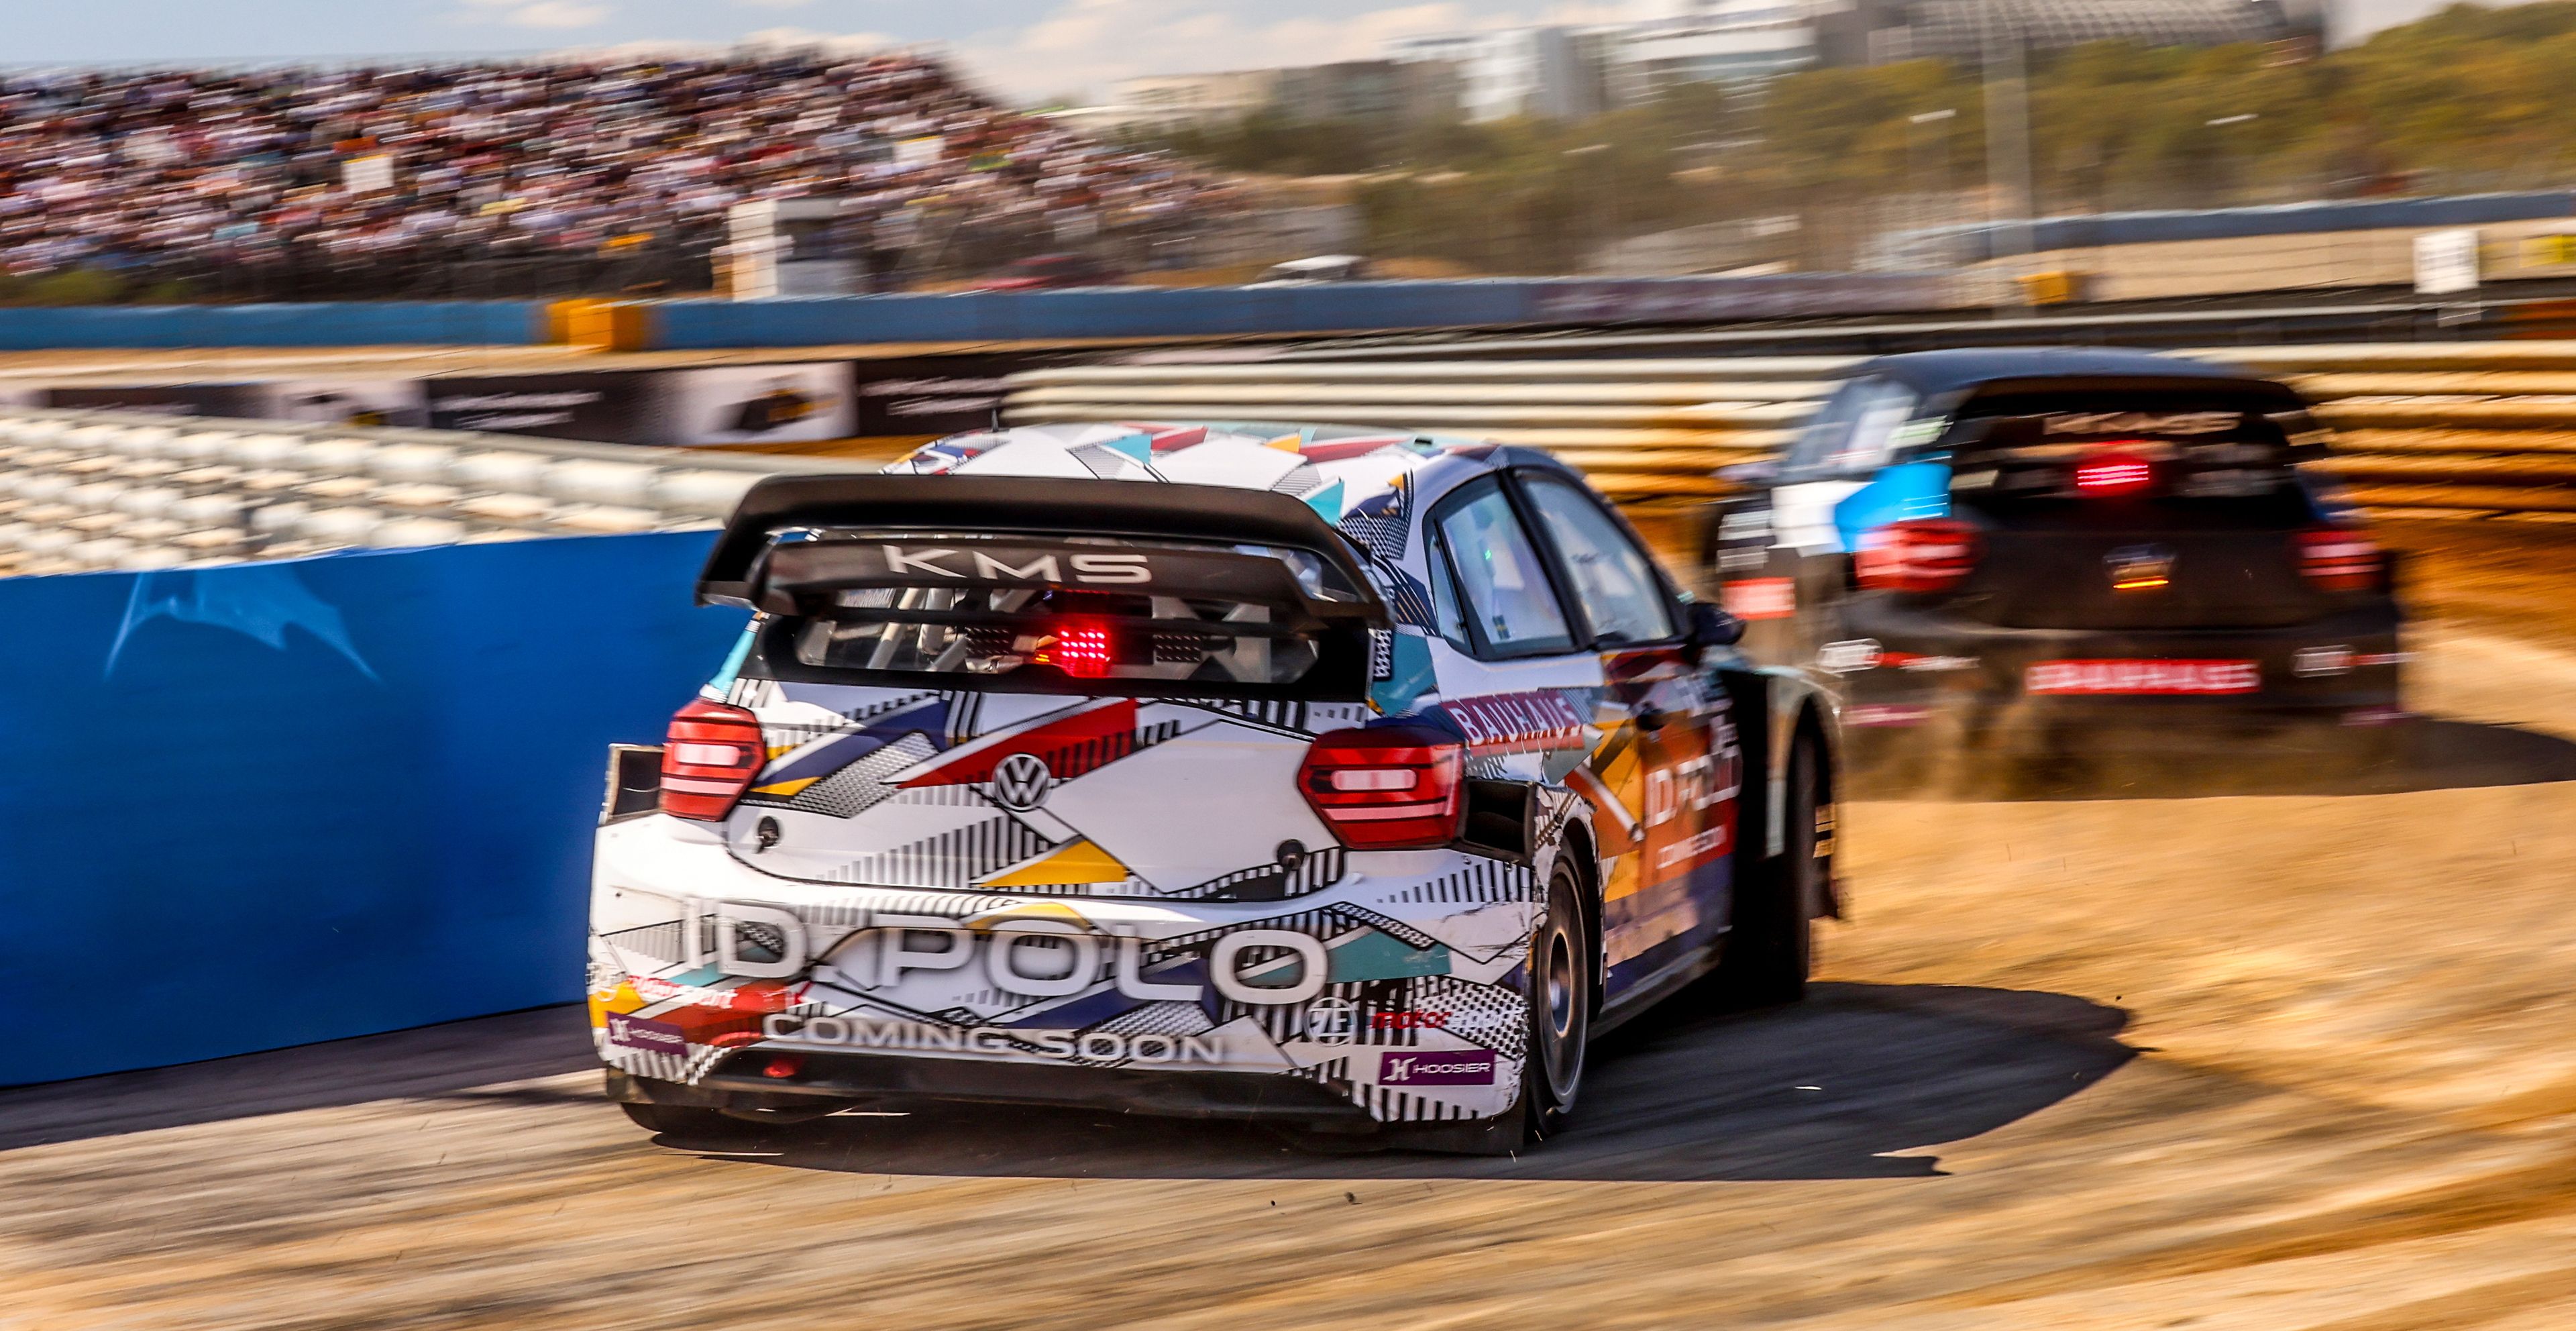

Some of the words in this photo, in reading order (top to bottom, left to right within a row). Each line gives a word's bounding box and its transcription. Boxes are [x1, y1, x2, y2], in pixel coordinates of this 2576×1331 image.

[881, 543, 1151, 584] KMS
[872, 913, 1328, 1005] POLO
[763, 1013, 1007, 1055] COMING
[1038, 1030, 1222, 1064] SOON
[1412, 1062, 1491, 1074] HOOSIER
